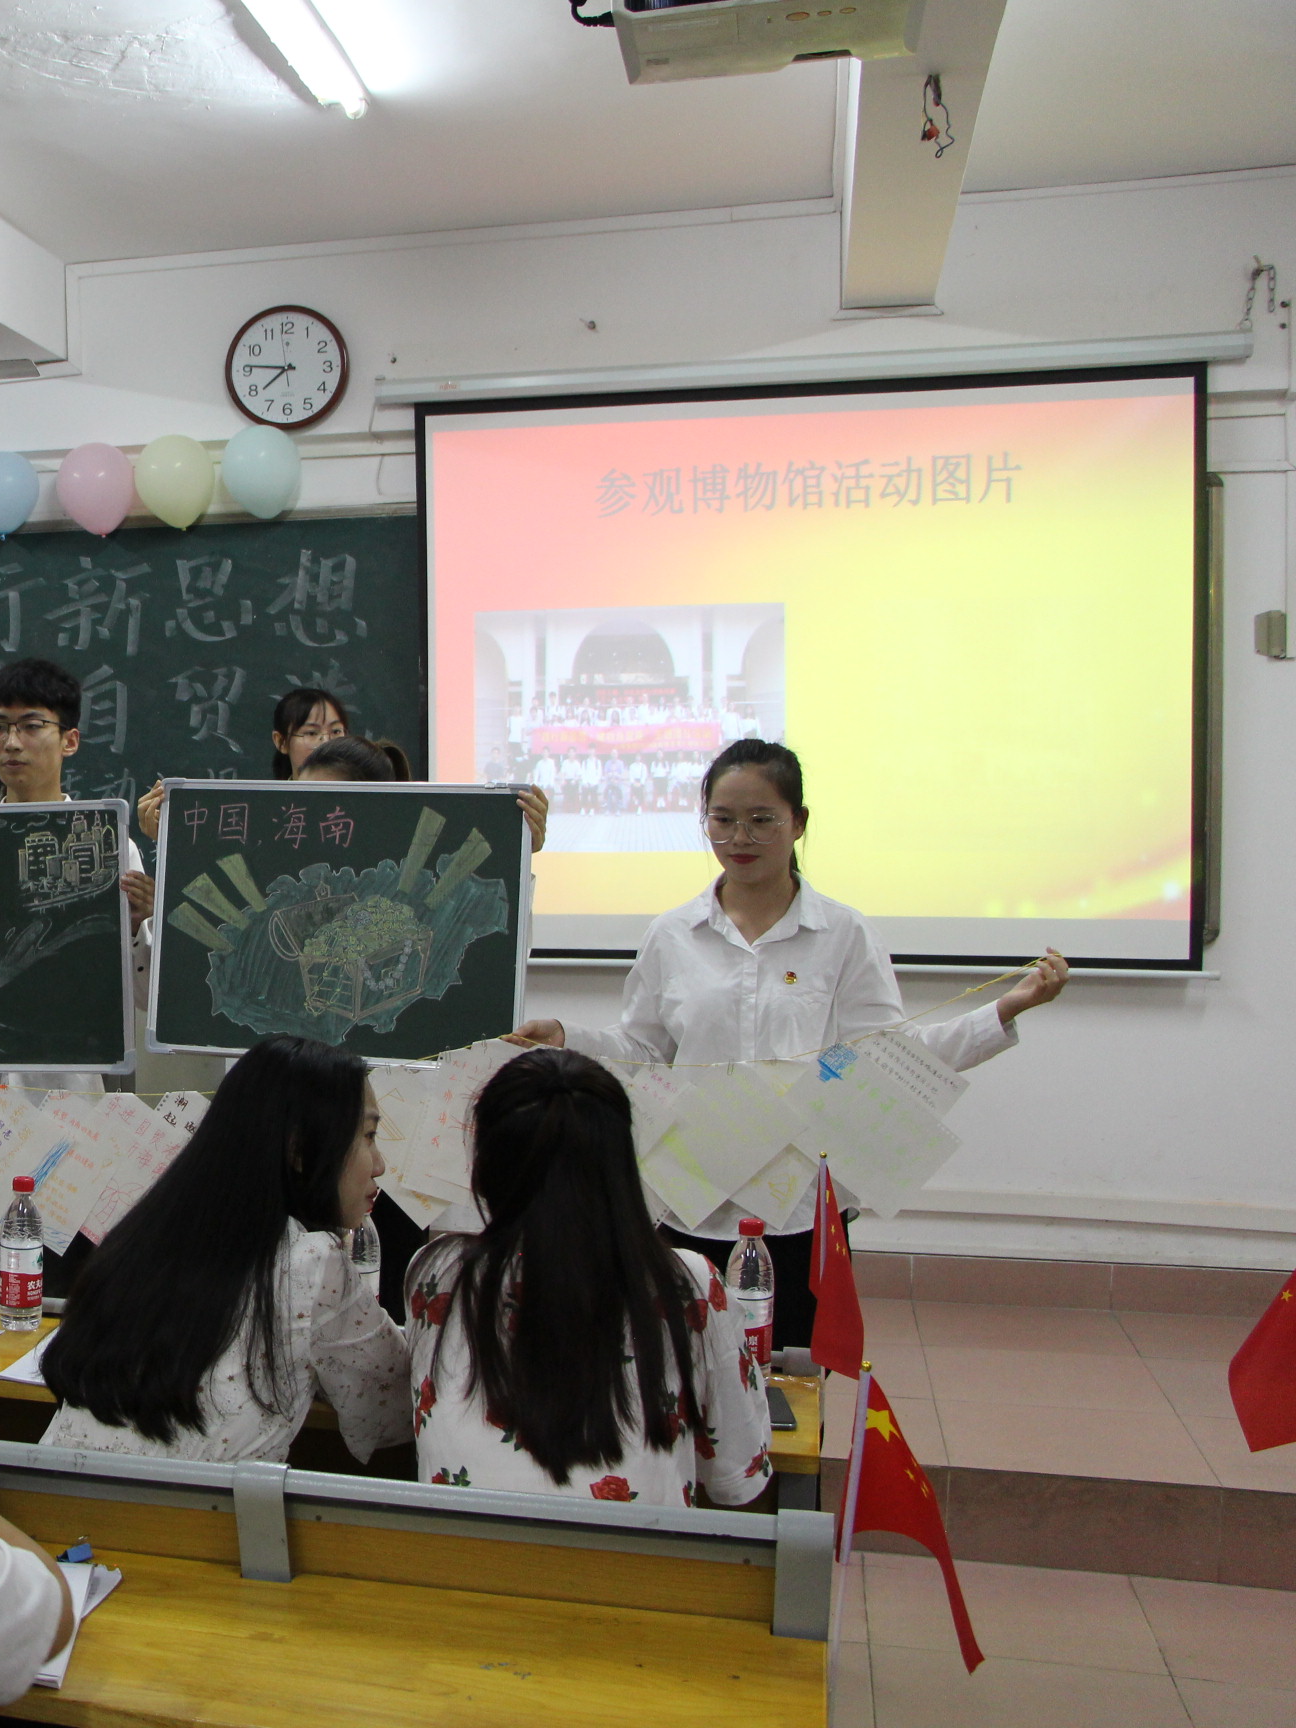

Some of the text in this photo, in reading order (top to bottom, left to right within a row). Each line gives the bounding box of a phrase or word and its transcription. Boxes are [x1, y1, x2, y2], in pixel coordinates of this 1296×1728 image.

[264, 328, 274, 341] 11
[280, 321, 295, 335] 12
[248, 343, 262, 357] 10
[317, 340, 328, 353] 2
[322, 360, 333, 373] 3
[248, 384, 259, 397] 8
[317, 381, 327, 394] 4
[264, 399, 275, 412] 7
[282, 402, 293, 416] 6
[303, 397, 313, 411] 5
[596, 451, 1024, 518] 参观博物馆活动图片
